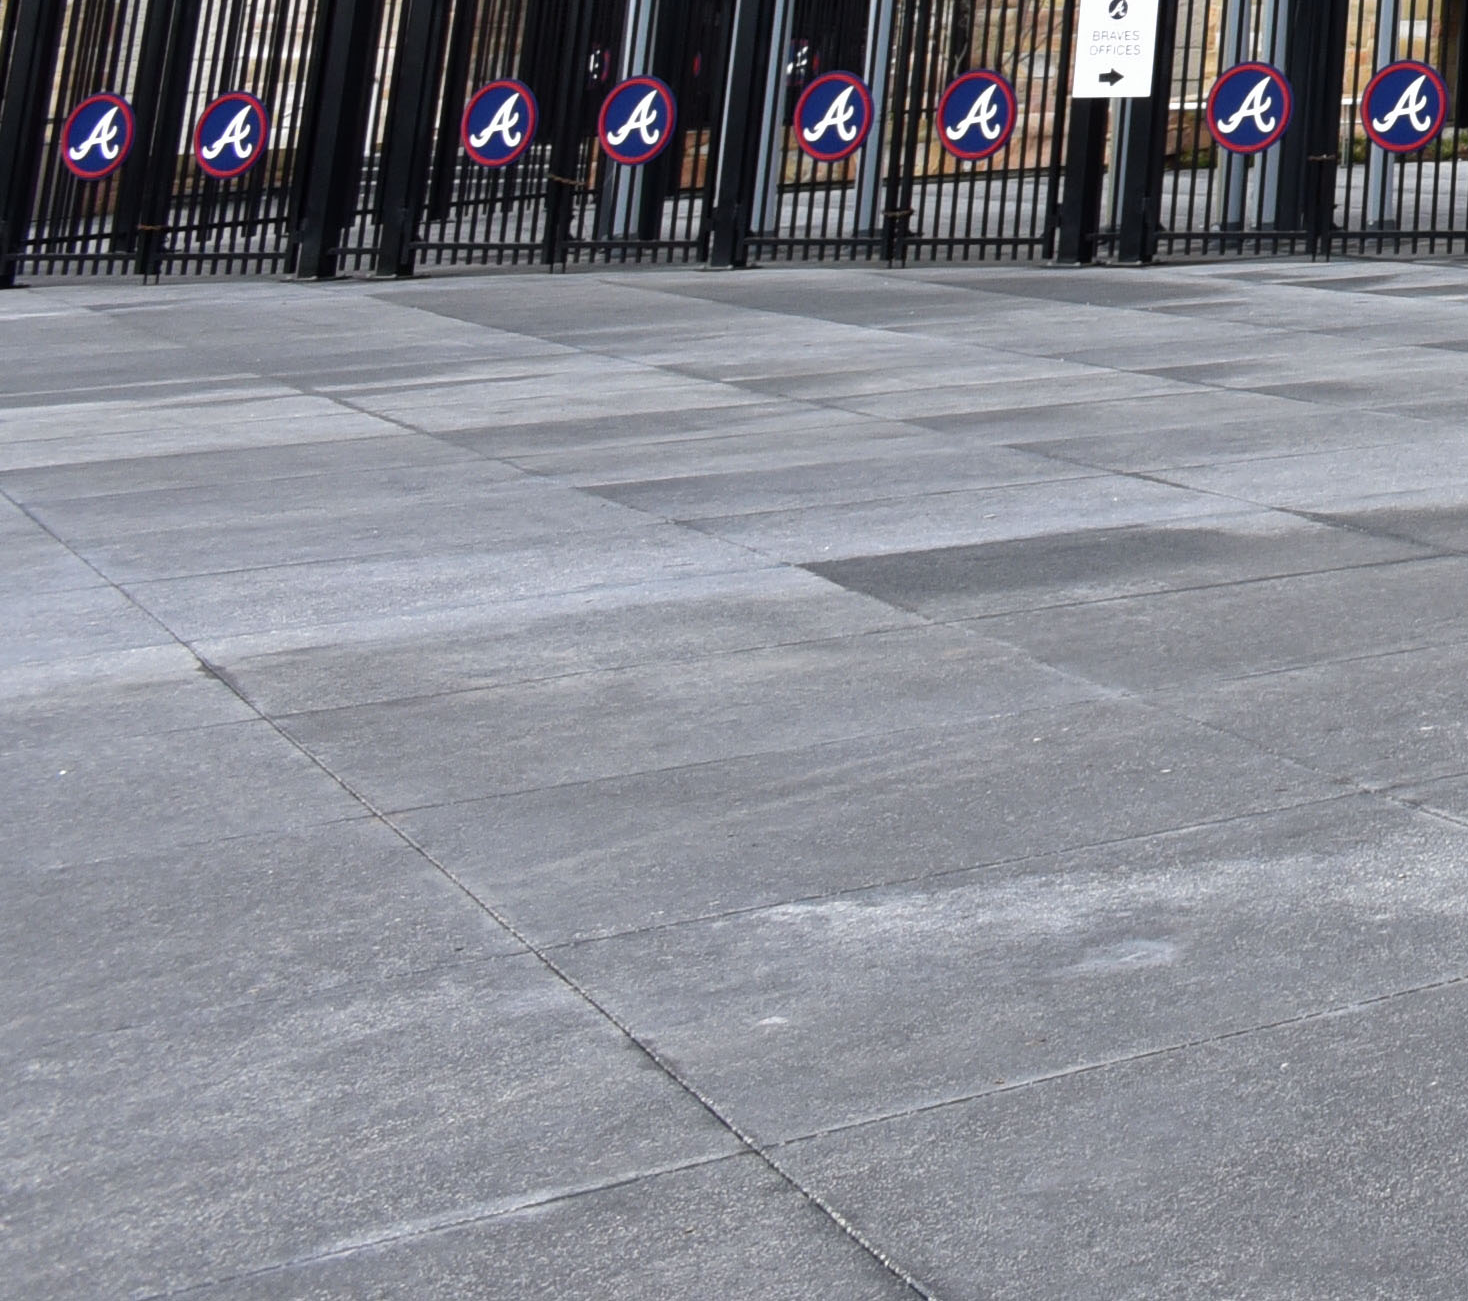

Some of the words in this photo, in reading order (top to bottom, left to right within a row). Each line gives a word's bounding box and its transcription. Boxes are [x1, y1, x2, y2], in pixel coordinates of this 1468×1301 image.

[1090, 45, 1141, 56] OFFICES
[1093, 30, 1140, 41] BRAVES
[469, 93, 521, 147] A
[607, 90, 659, 145] A
[803, 86, 856, 141] A
[946, 84, 1000, 140] A
[1217, 76, 1275, 133] A
[1373, 75, 1431, 132] A
[70, 107, 118, 160] A
[202, 105, 252, 159] A
